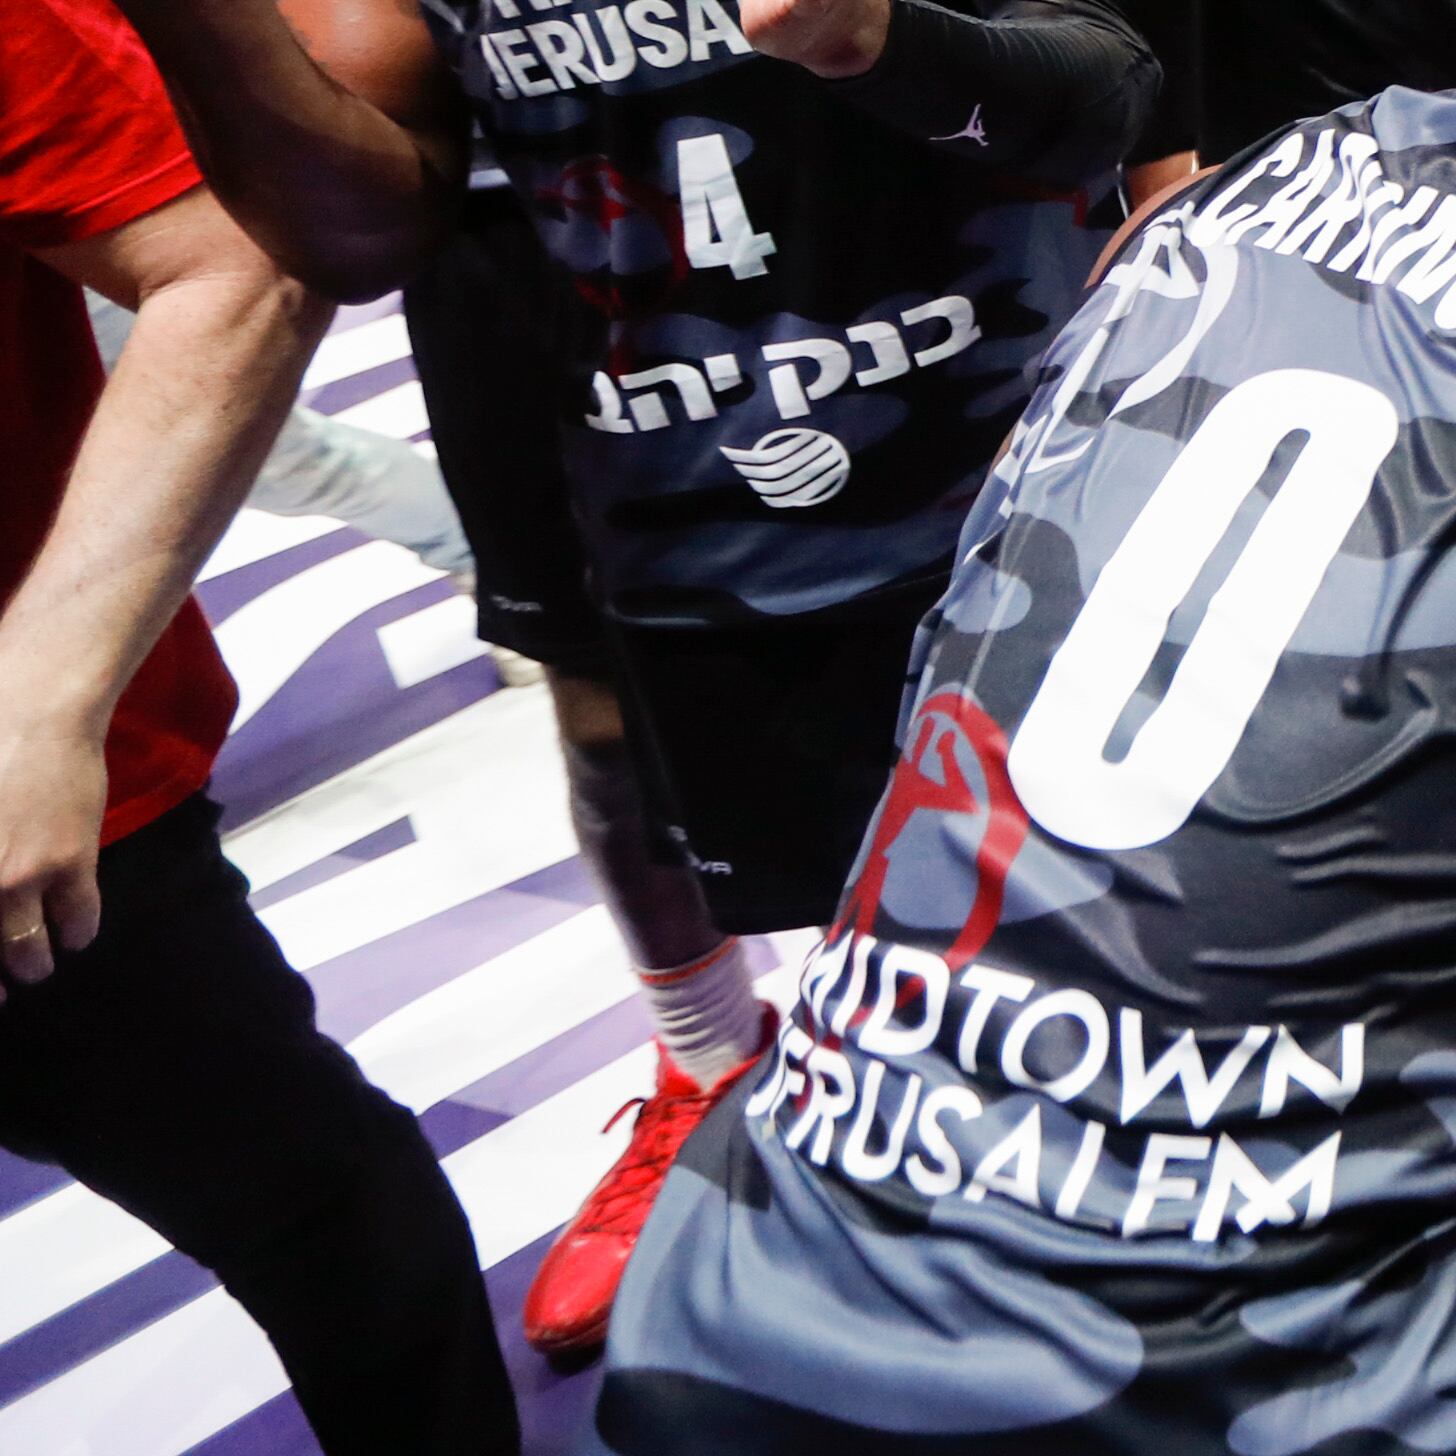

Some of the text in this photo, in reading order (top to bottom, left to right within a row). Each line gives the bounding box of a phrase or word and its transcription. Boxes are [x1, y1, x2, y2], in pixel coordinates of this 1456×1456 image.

[676, 132, 778, 281] 4
[584, 295, 982, 434] בנק יהב
[1006, 367, 1400, 851] 0
[800, 929, 1366, 1131] MIDTOWN
